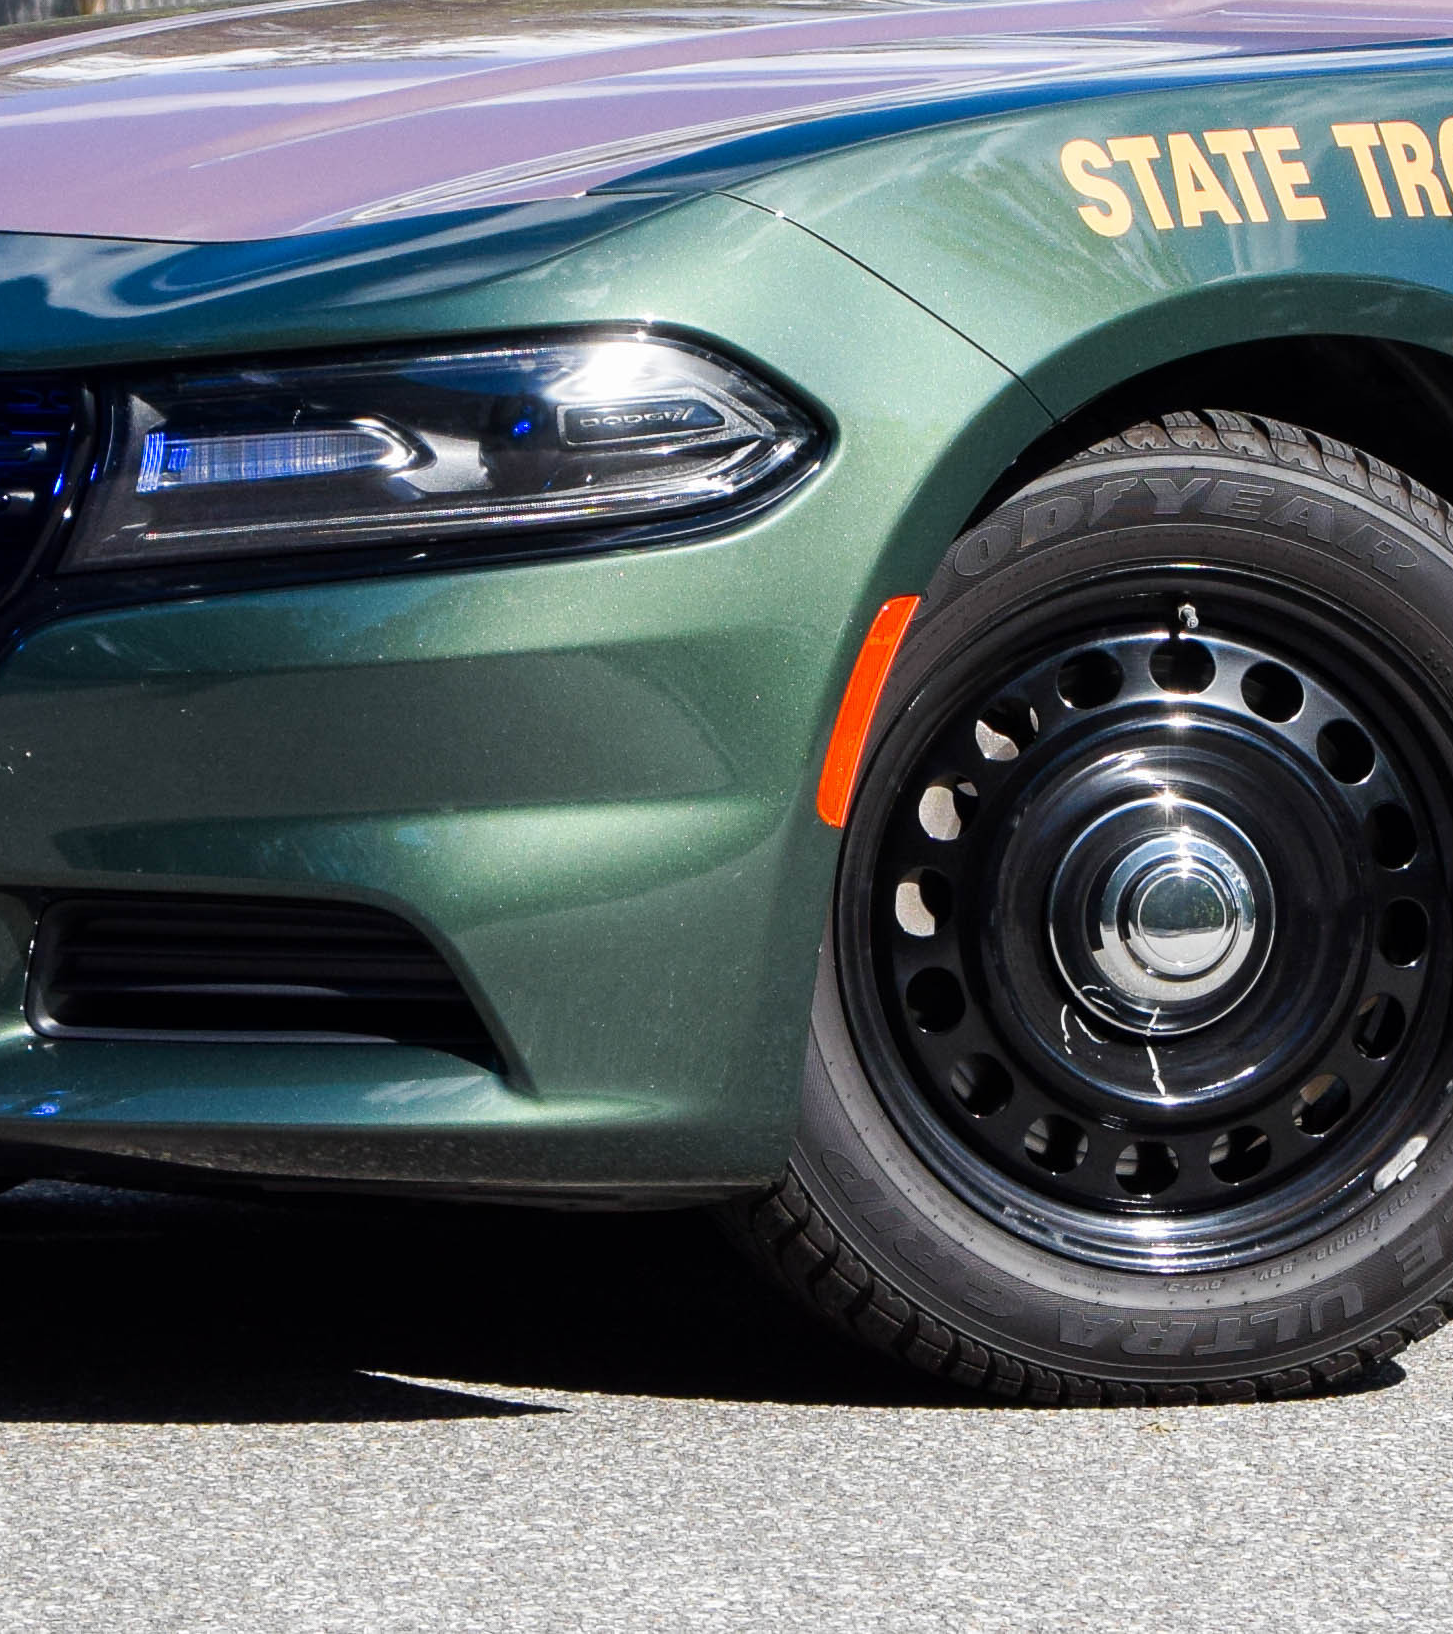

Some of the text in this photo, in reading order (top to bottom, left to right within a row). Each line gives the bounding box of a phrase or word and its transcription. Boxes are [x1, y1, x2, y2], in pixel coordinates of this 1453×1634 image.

[1059, 126, 1327, 239] STATE
[820, 1149, 1026, 1318] GRIP
[1058, 1281, 1365, 1356] ULTRA
